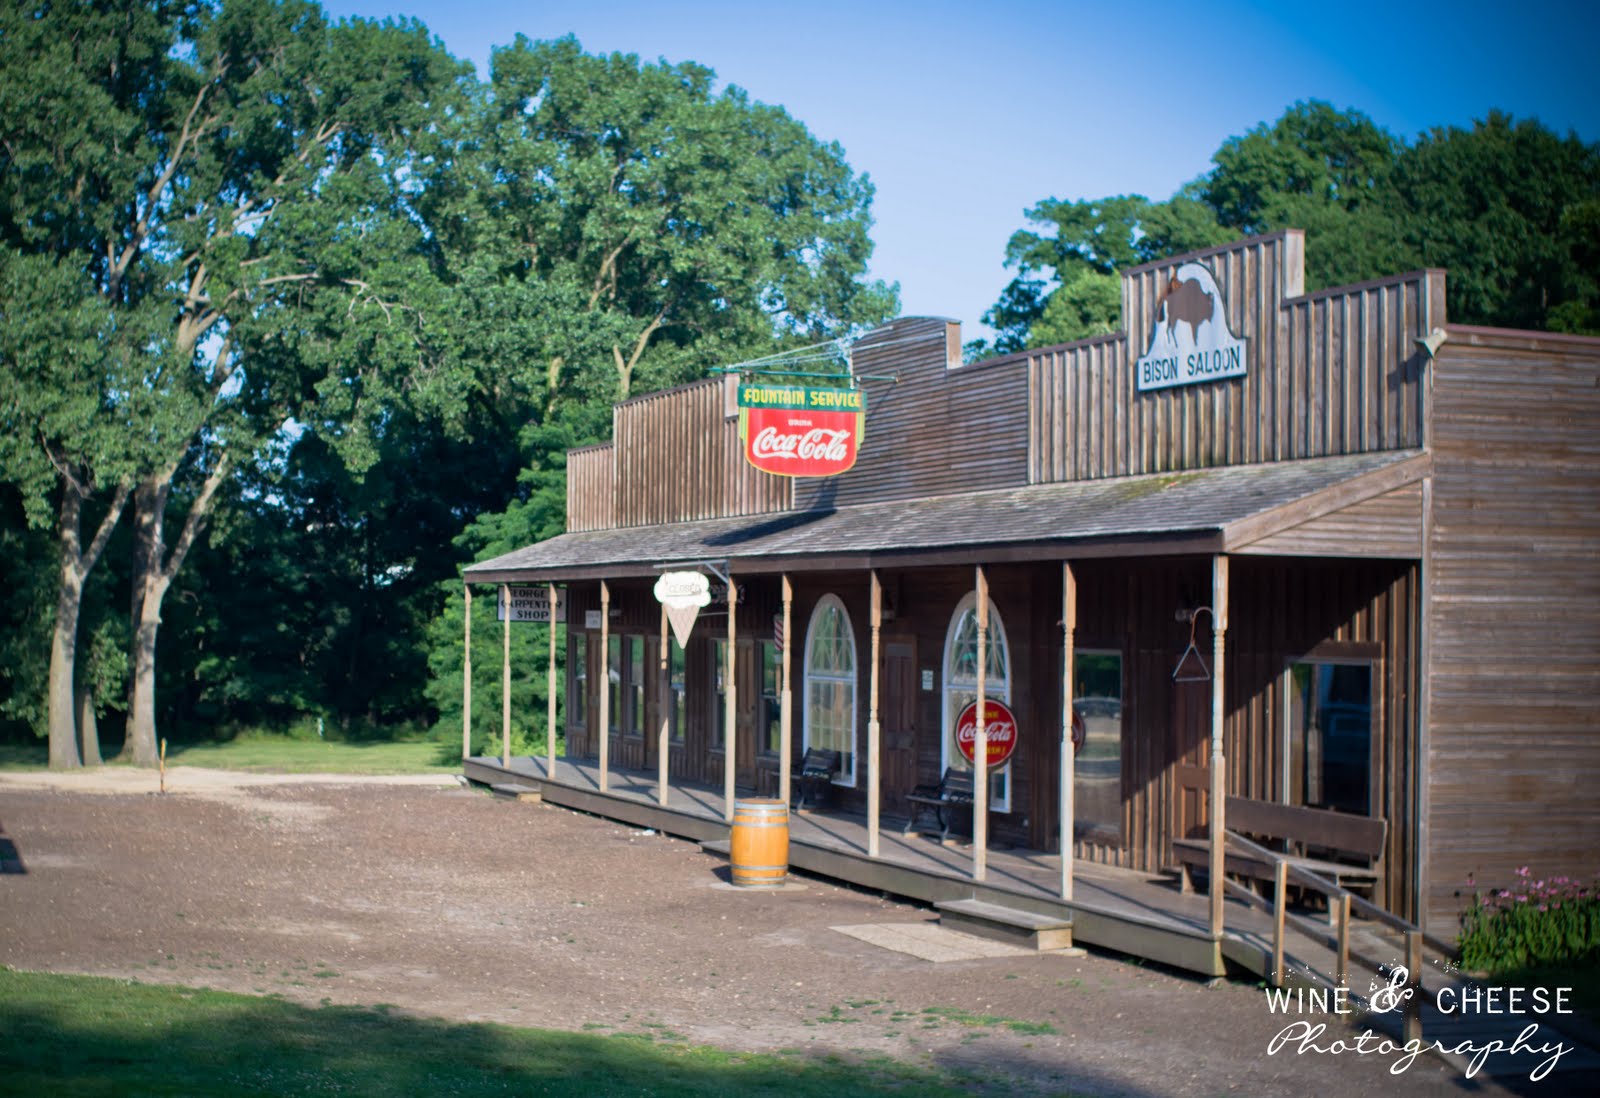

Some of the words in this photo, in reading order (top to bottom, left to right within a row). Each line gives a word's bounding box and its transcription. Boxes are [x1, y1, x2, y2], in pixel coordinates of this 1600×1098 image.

[1144, 357, 1178, 383] BISON
[1187, 345, 1240, 376] SALOON
[744, 388, 805, 405] FOUNTAIN
[810, 391, 861, 407] SERVICE
[752, 427, 851, 461] Coca-Cola
[510, 589, 546, 598] EORGE
[517, 610, 549, 619] SHOP
